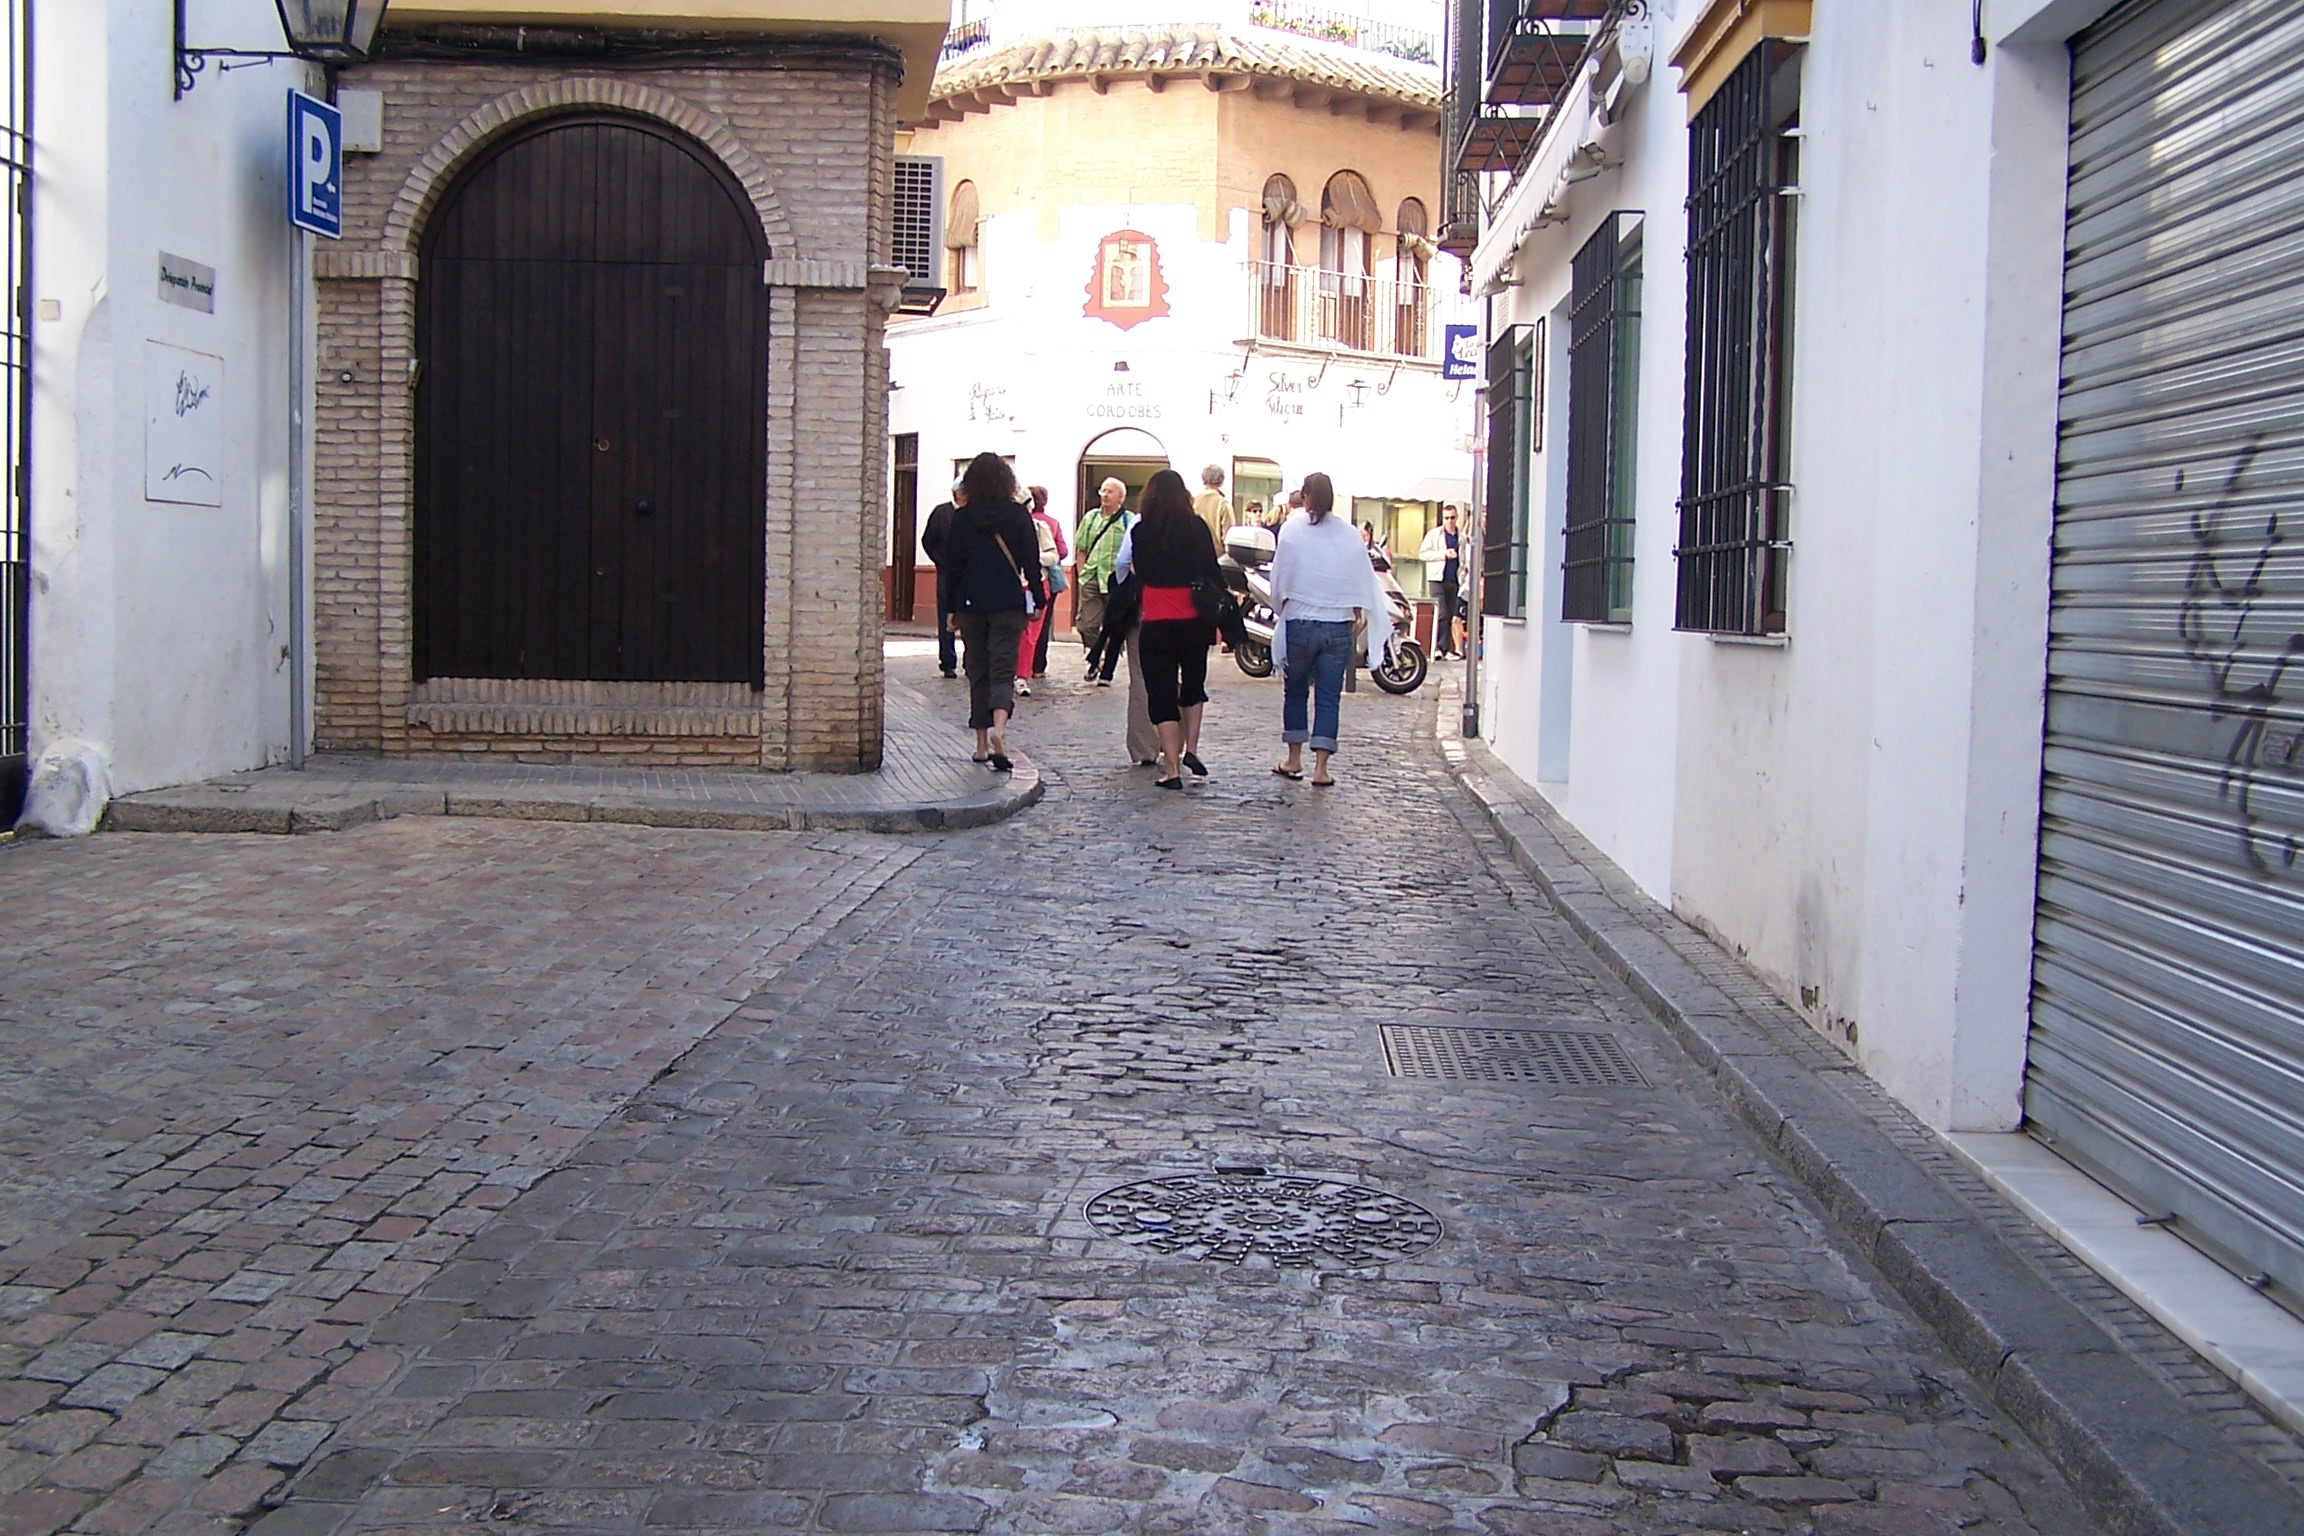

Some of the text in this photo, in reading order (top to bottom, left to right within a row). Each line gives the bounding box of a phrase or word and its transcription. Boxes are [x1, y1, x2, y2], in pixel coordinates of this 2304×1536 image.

[302, 109, 332, 214] P
[1449, 363, 1477, 376] Hela
[1106, 382, 1142, 397] ARTE
[1267, 371, 1302, 395] Silver
[1086, 403, 1162, 419] CORDOBES
